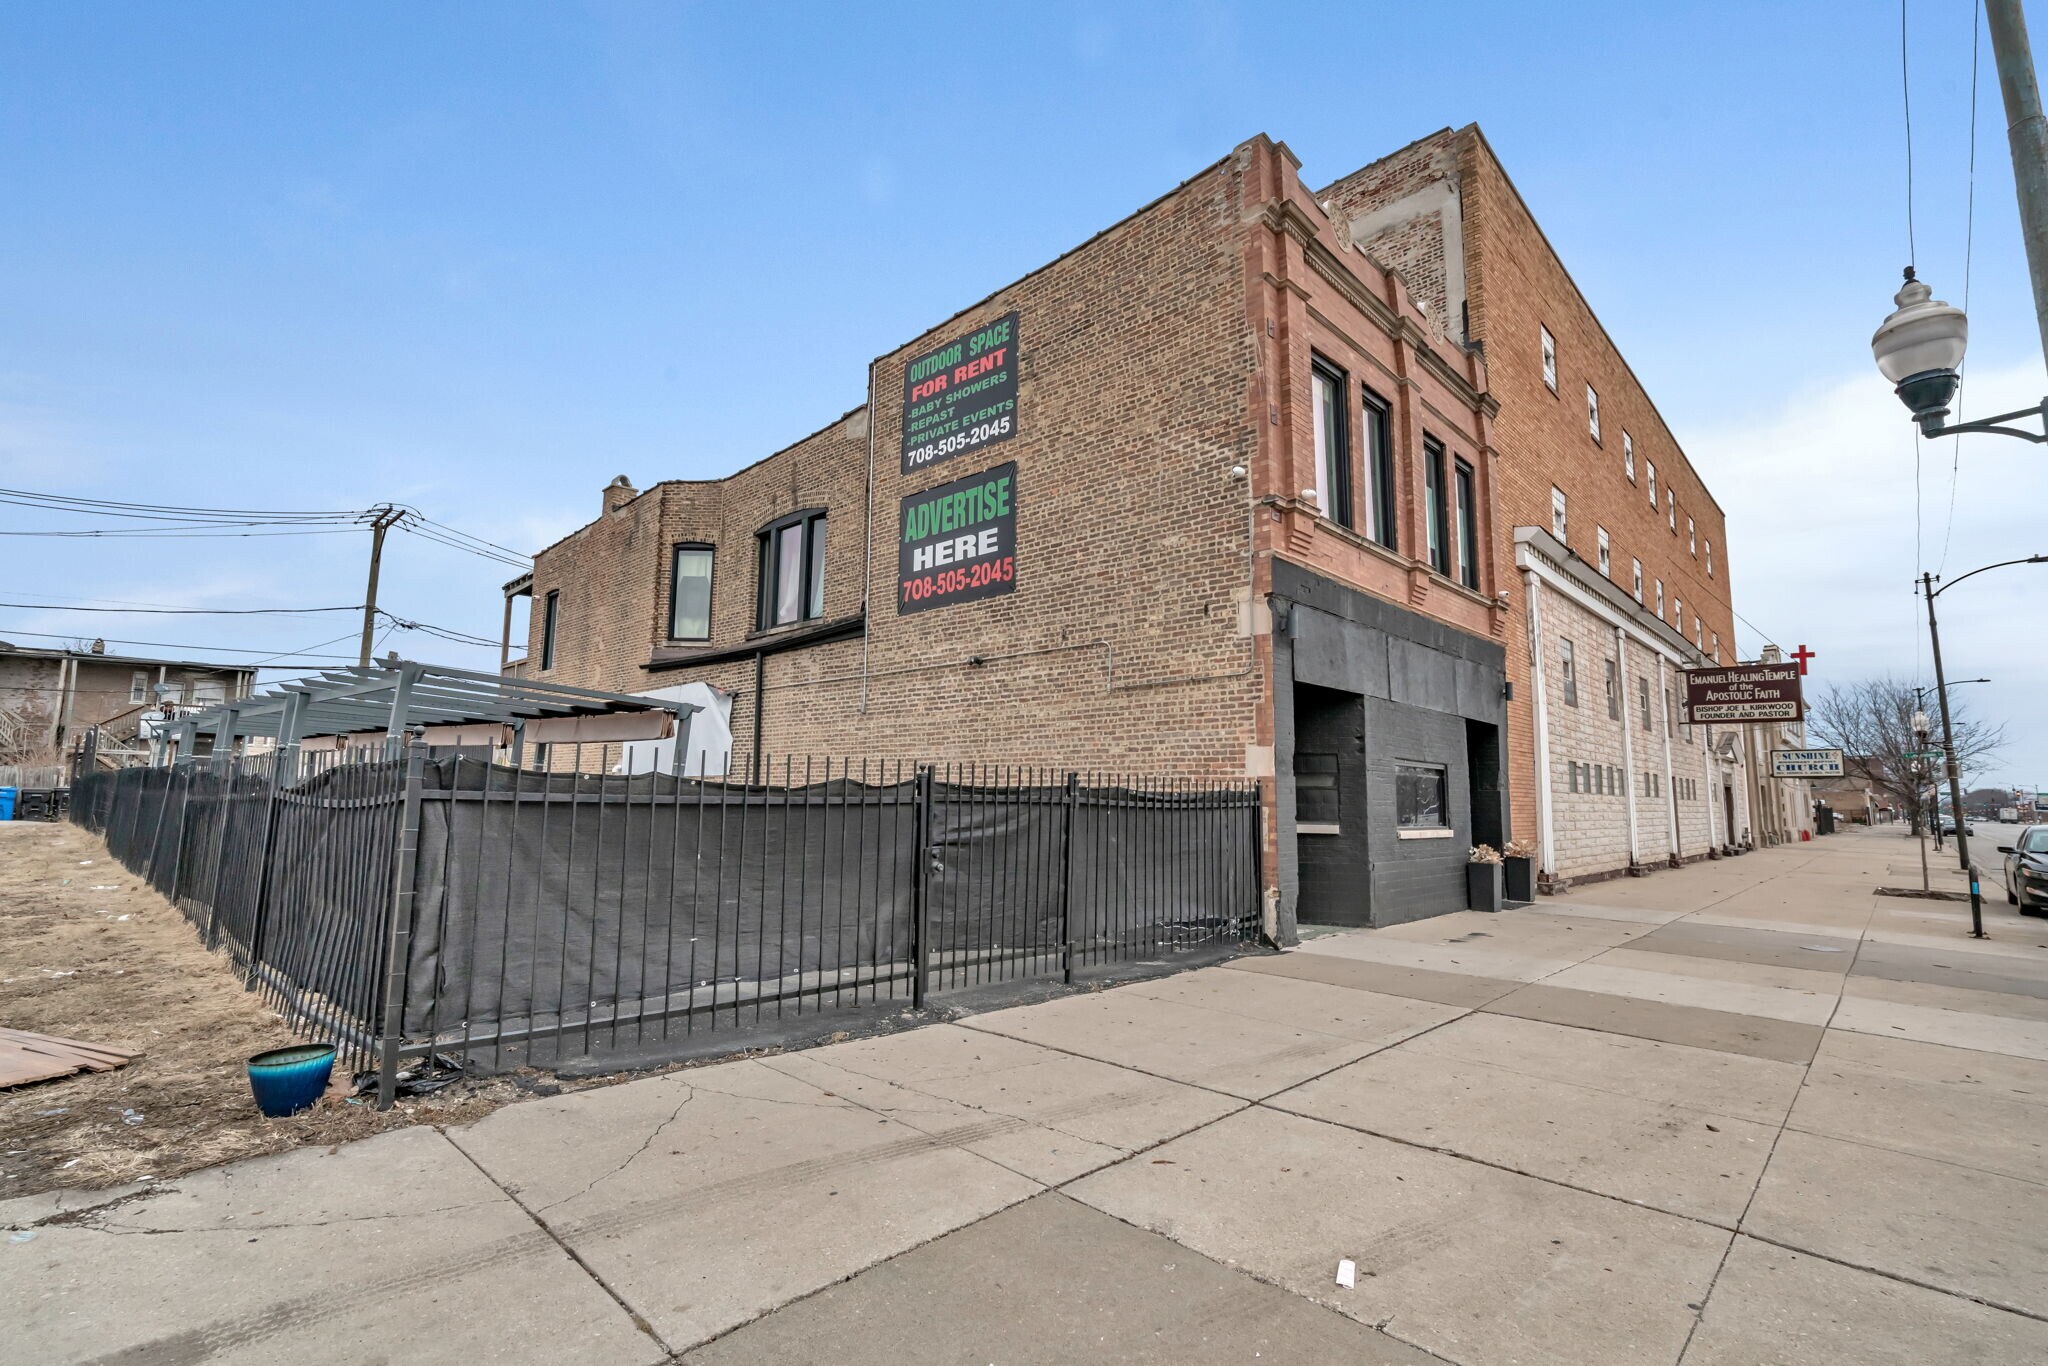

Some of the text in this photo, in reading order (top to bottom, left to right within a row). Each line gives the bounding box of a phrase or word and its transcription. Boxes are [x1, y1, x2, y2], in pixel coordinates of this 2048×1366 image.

[910, 321, 1010, 383] OUTDOOR SPACE
[912, 348, 1007, 402] FOR RENT
[908, 371, 1008, 419] -BABY SHOWERS
[906, 399, 1014, 447] -PRIVATE EVENTS
[907, 406, 956, 432] -REPAST
[908, 416, 1010, 467] 708-505-2045
[904, 476, 1010, 543] ADVERTISE
[913, 527, 999, 572] HERE
[903, 556, 1013, 602] 708-505-2045
[1690, 669, 1796, 685] EMANUEL HEALING TEMPLE
[1706, 687, 1780, 701] APOSTOLIC FAITH
[1729, 682, 1754, 690] of the
[1696, 705, 1723, 713] BISHOP
[1750, 702, 1793, 711] KIRKWOOD
[1758, 710, 1790, 718] PASTOR
[1776, 763, 1840, 771] CHURCH
[1782, 752, 1831, 760] SUNSHINE
